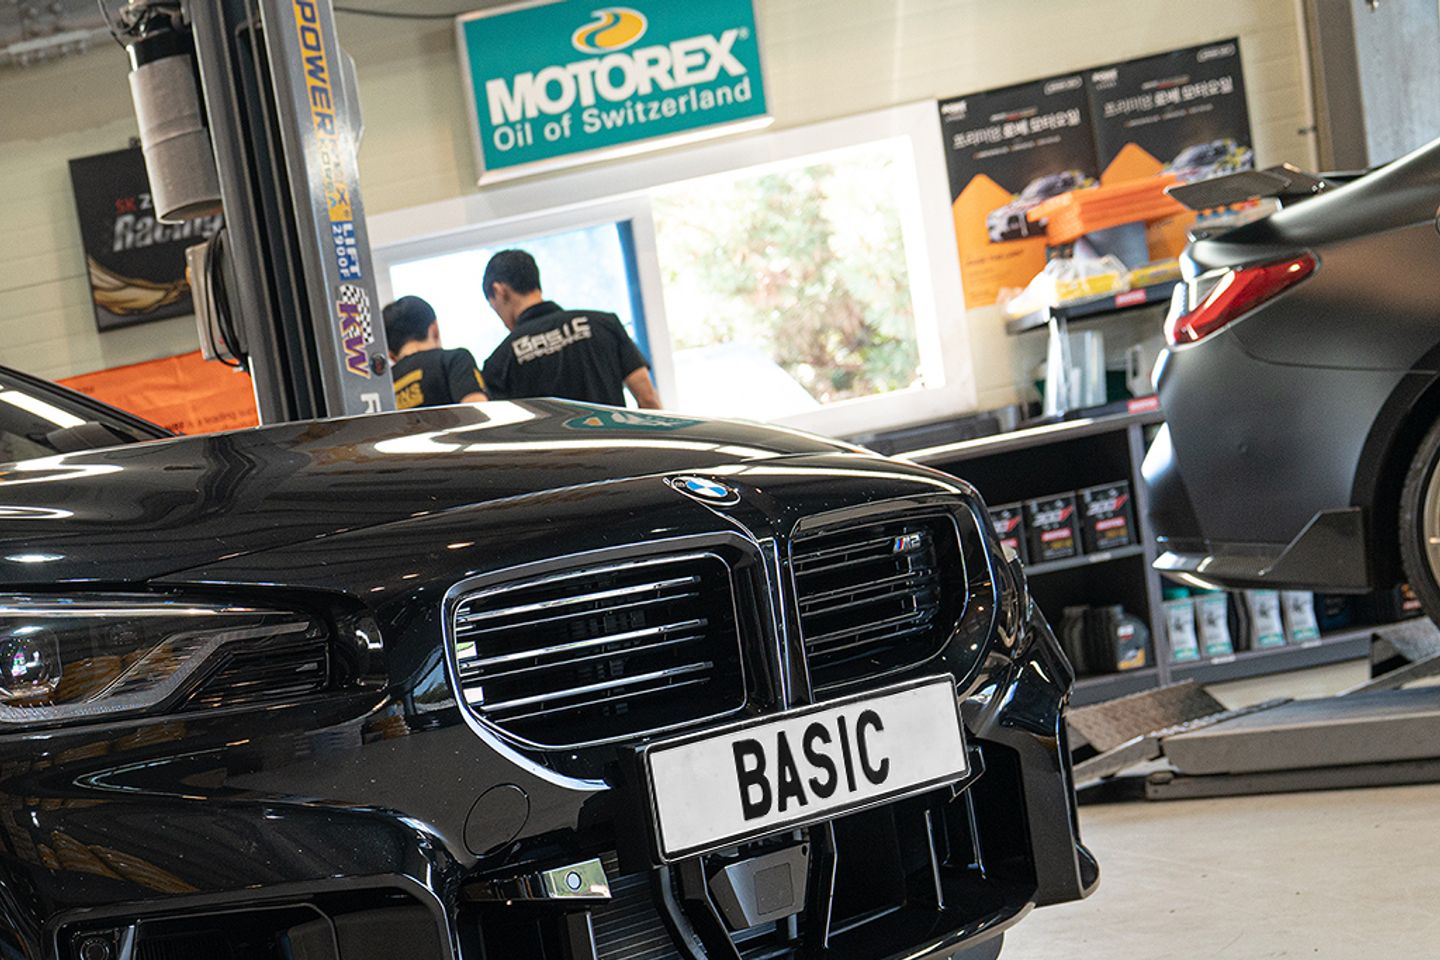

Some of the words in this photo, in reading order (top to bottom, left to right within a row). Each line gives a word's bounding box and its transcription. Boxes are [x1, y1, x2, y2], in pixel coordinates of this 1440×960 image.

[485, 28, 748, 126] MOTOREX
[493, 122, 533, 151] Oil
[544, 114, 572, 142] of
[582, 76, 752, 134] Switzerland
[342, 223, 362, 277] LIFT
[337, 301, 371, 379] KW
[732, 709, 890, 821] BASIC
